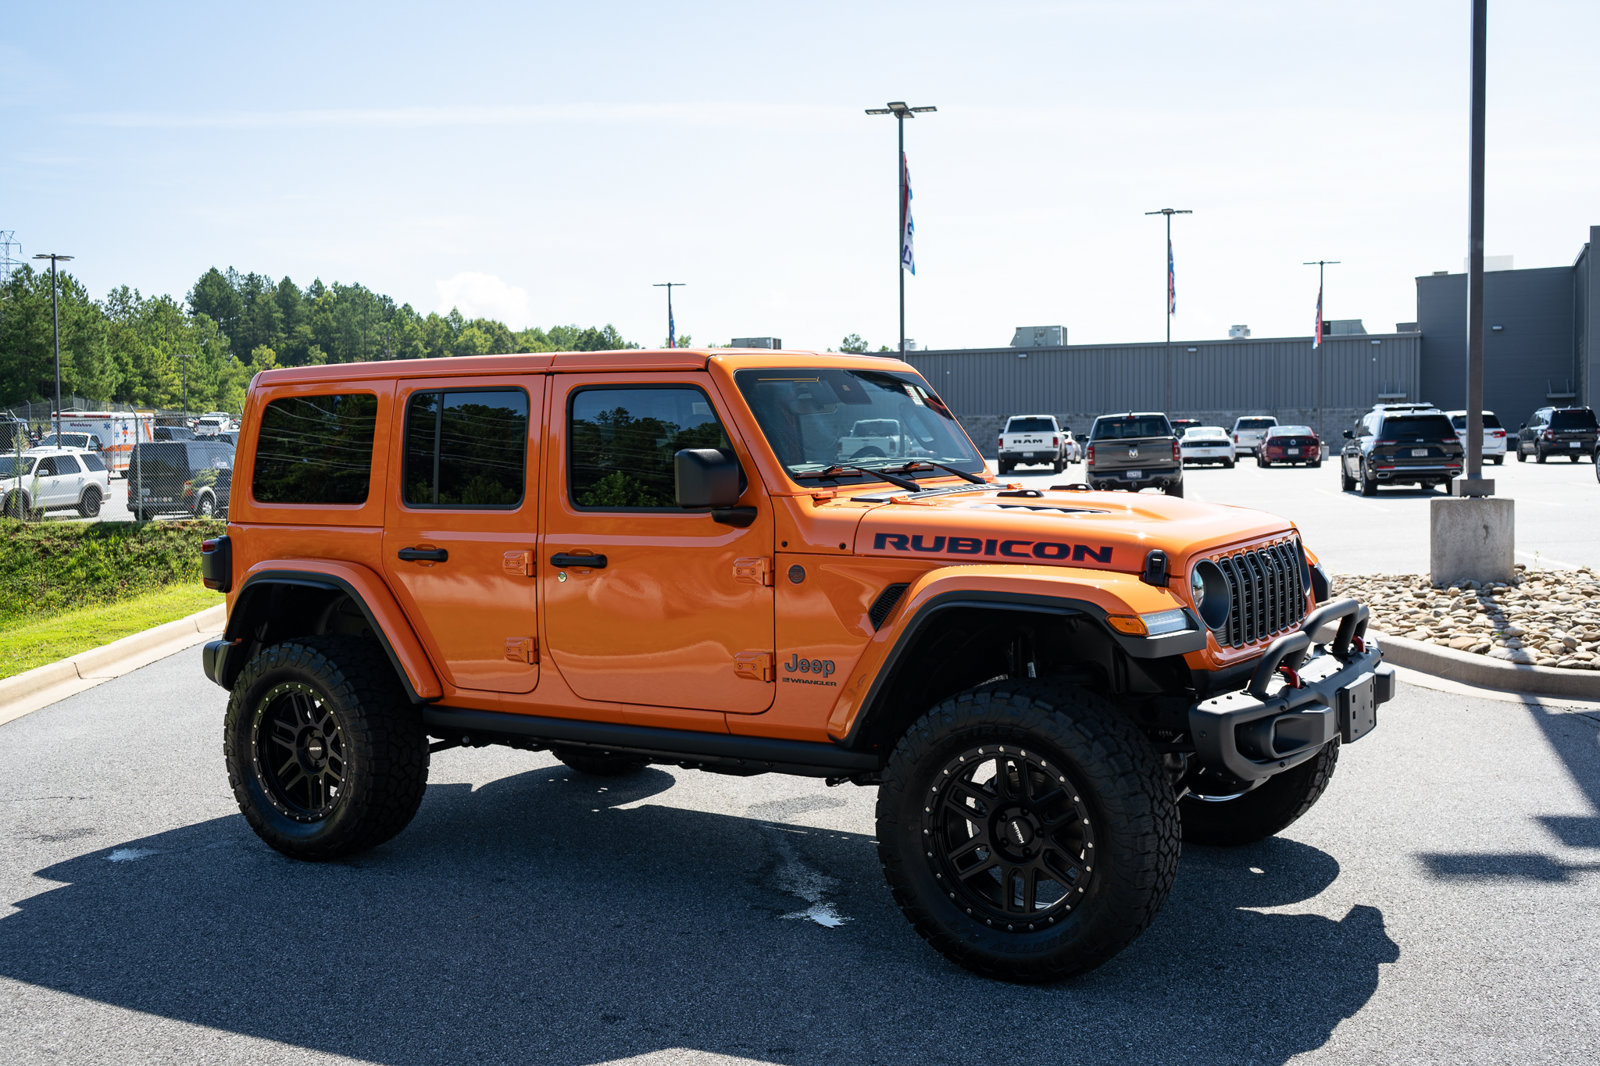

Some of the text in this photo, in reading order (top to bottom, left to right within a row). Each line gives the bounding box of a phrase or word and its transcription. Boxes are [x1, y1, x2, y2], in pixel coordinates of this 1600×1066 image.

[873, 533, 1114, 563] RUBICON
[784, 653, 835, 678] Jeep
[790, 678, 837, 686] WRANGLER
